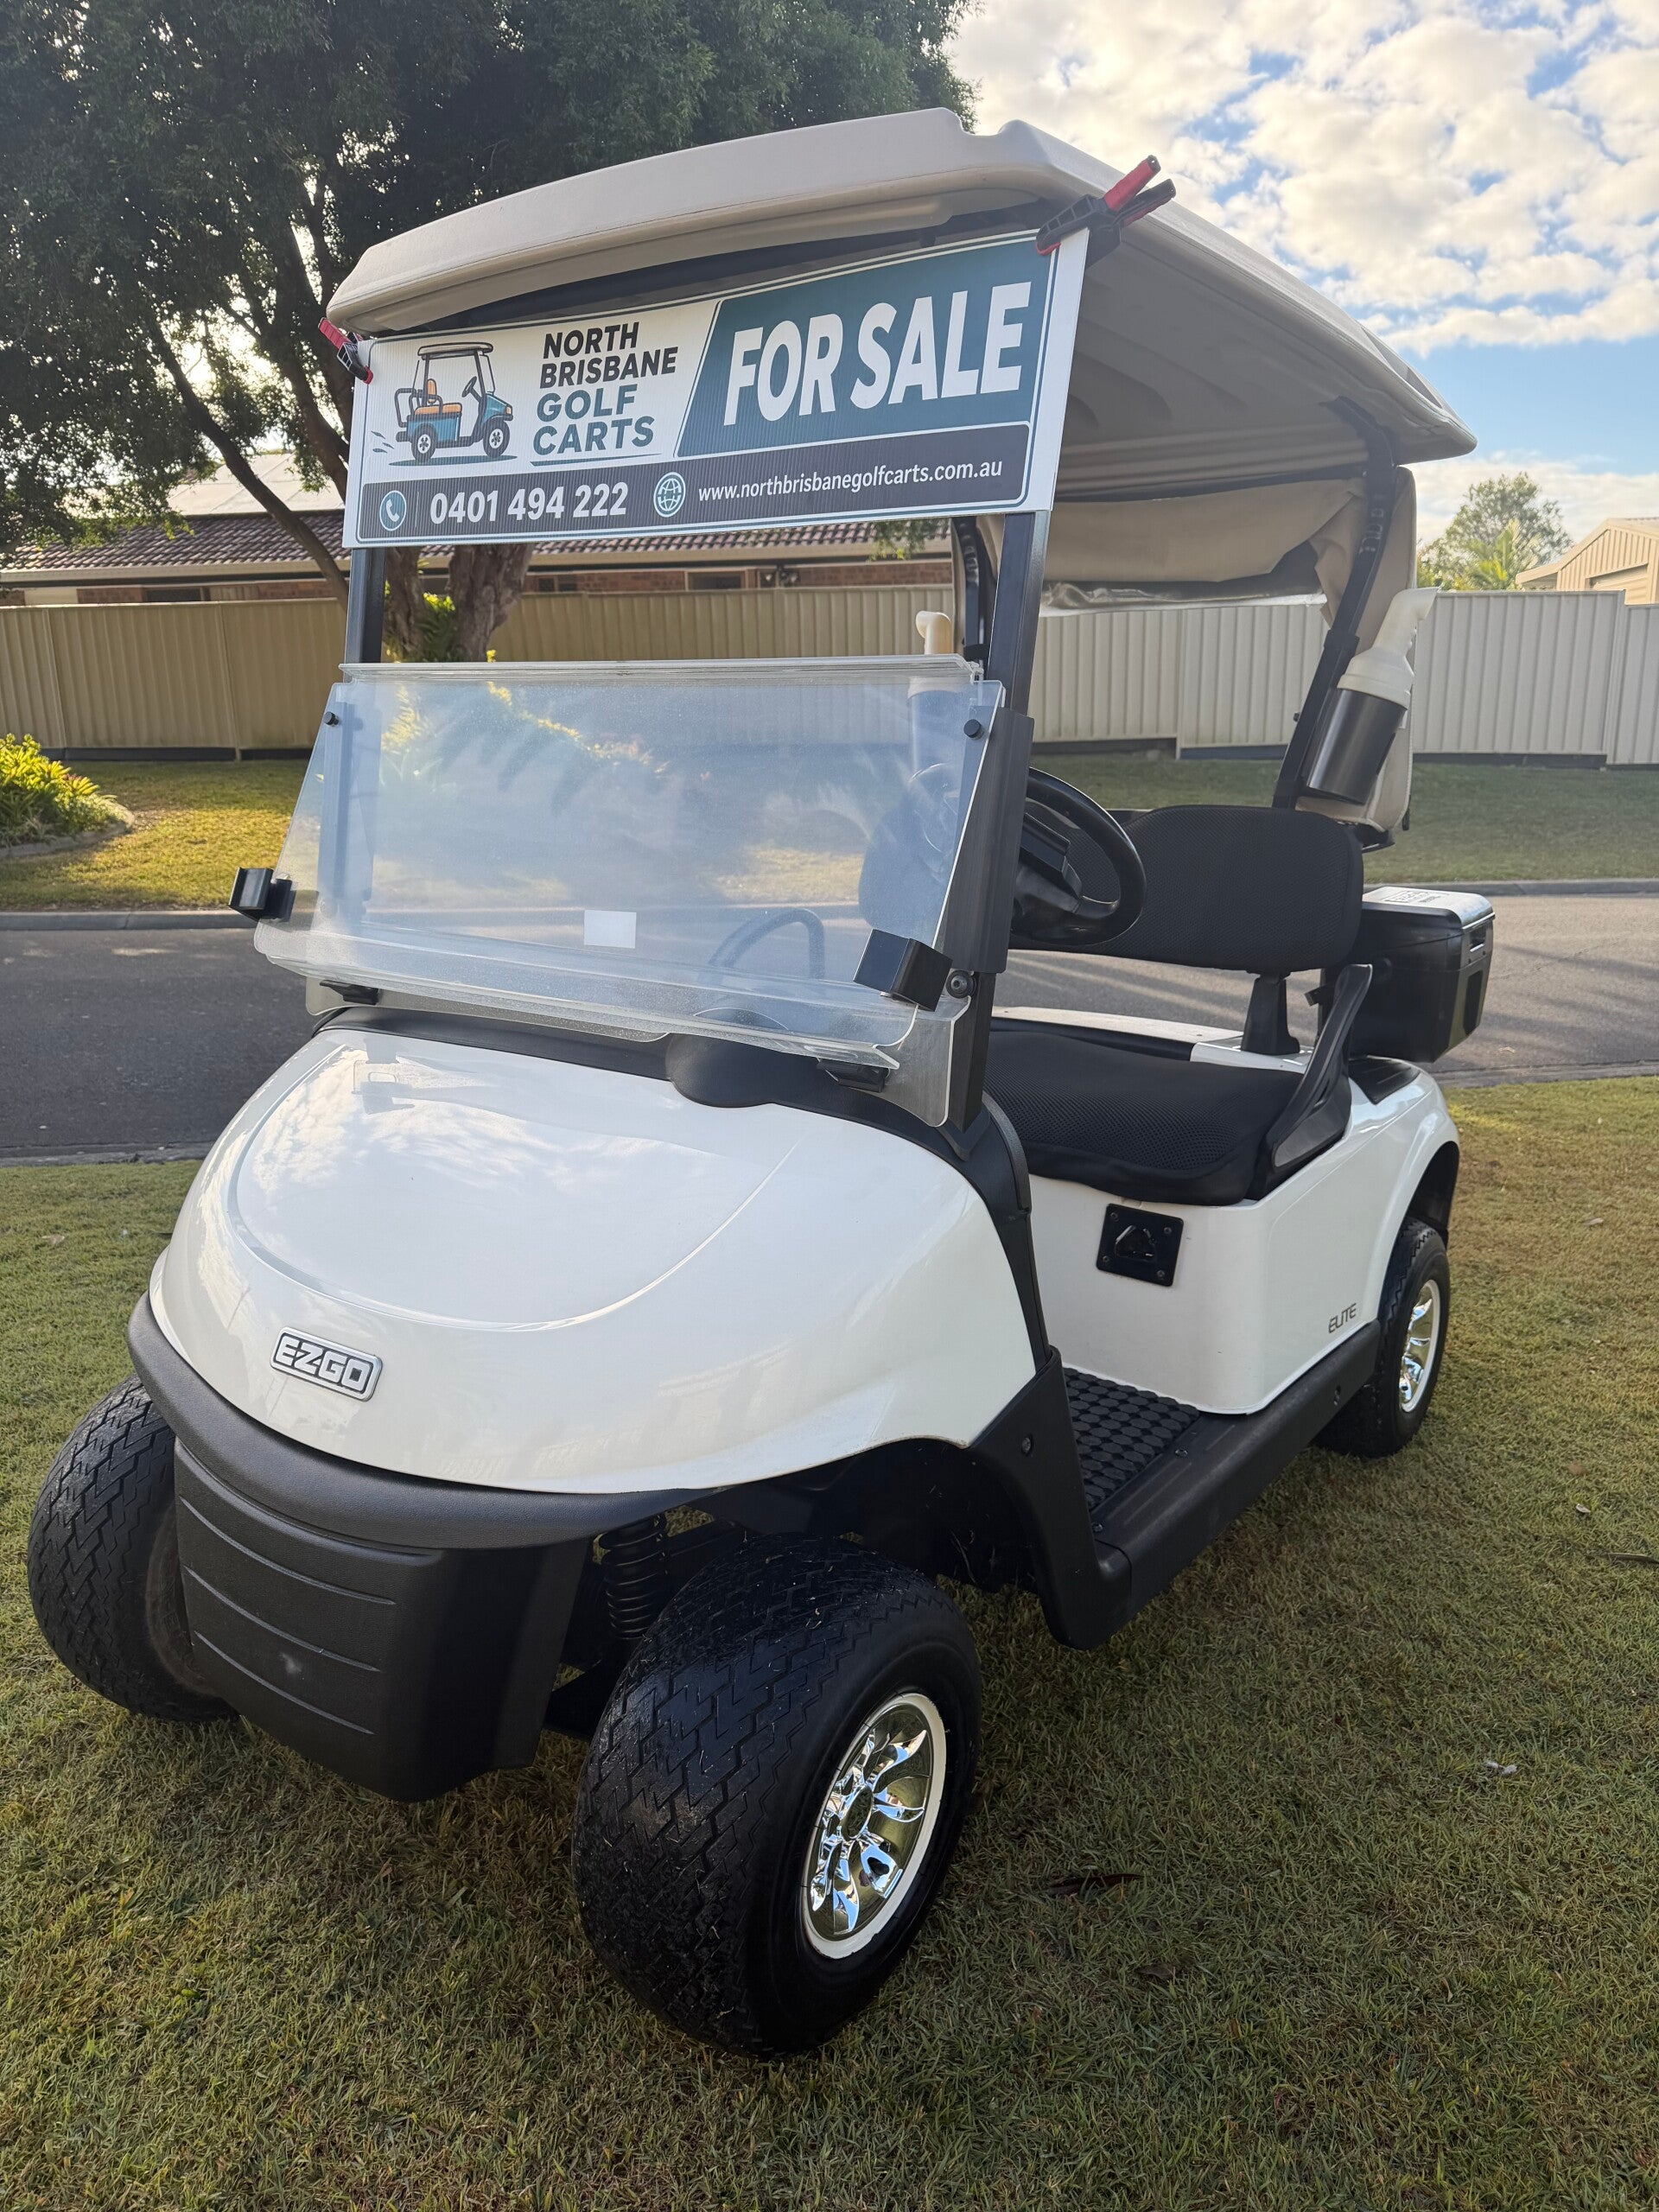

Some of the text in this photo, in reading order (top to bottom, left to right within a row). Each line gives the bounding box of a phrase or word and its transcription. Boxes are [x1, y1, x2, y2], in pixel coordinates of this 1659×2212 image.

[543, 322, 639, 359] NORTH
[724, 282, 1032, 426] FOR SALE
[540, 346, 678, 389] BRISBANE
[537, 384, 638, 422] GOLF
[533, 416, 655, 455] CARTS
[698, 461, 1003, 501] www.northbrisbanegolfcarts.com.au
[430, 481, 629, 524] 0401 494 222
[1328, 1302, 1357, 1333] ELITE
[275, 1335, 371, 1391] EZGO
